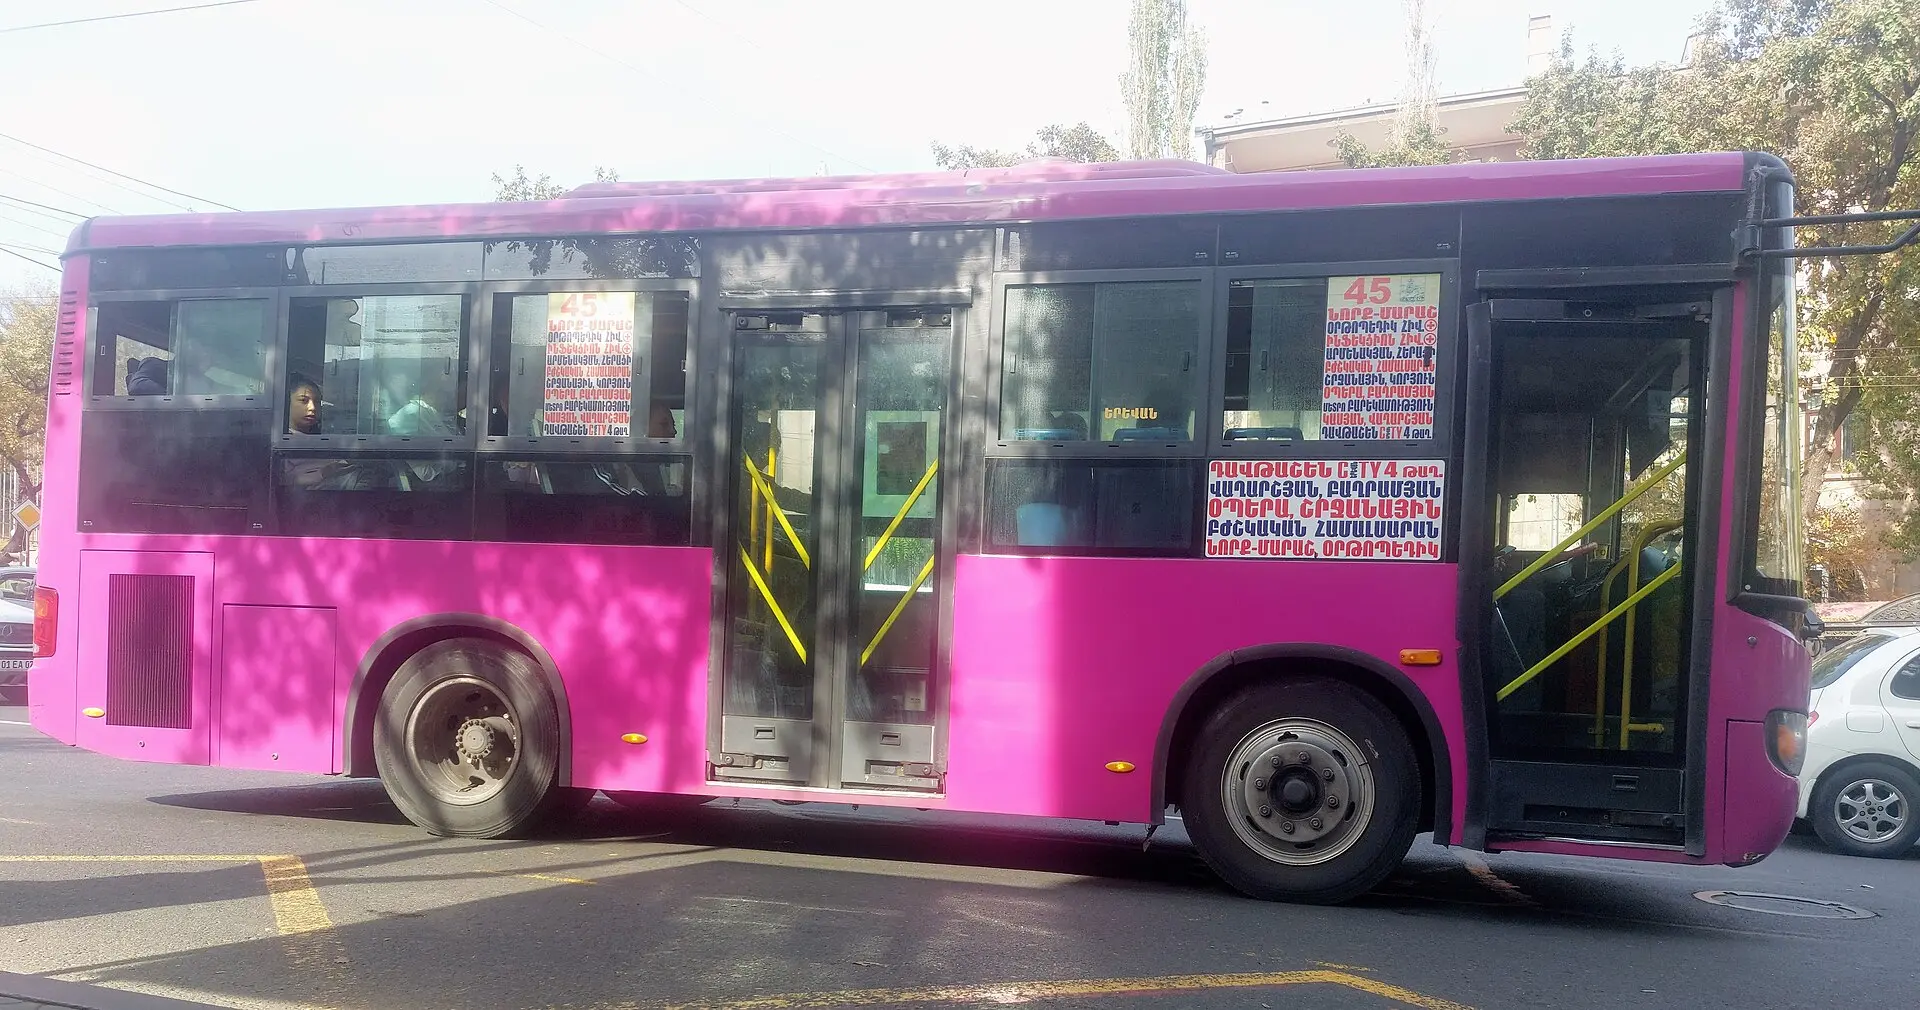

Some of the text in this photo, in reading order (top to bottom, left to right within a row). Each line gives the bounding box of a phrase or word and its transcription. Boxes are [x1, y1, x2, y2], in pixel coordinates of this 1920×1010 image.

[1343, 277, 1391, 305] 45
[561, 294, 597, 317] 45
[1327, 305, 1438, 321] ՆՈՐՔ-ՄԱՐԱՇ
[1327, 320, 1425, 334] ՕՐԹՈՊԵԴԻԿ ՀԻՎ.
[1326, 333, 1396, 347] ԻՆՖԵԿՑԻՈՆ
[1325, 346, 1436, 360] ԱՐՄԵՆԱԿՅԱՆ, ՀԵՐԱ
[1324, 360, 1373, 374] ԲԺՇԿԱԿԱՆ
[1324, 372, 1435, 386] ՇՐՋԱՆԱՅԻՆ, ԿՈՐՅՈՒՆ
[1323, 385, 1435, 400] ՕՊԵՐԱ, ԲԱՂՐԱՄՅԱՆ
[1322, 399, 1433, 412] ՄԵՏՐՈ ԲԱՐԵԿԱՄՈՒԹՅՈՒՆ
[1104, 407, 1158, 419] ԵՐԵՎԱՆ
[1322, 412, 1433, 427] ԿԱՍՅԱՆ, ՎԱՂԱՐՇՅԱՆ
[607, 424, 613, 436] 4
[1321, 426, 1378, 439] ԴԱՎԹԱՇԵՆ
[1403, 425, 1411, 439] 4
[1210, 461, 1333, 478] ԴԱՎԹԱՇԵՆ
[1383, 461, 1398, 478] 4
[1402, 465, 1443, 478] ԹԱՂ.
[1209, 480, 1441, 499] ՎԱՂԱՐՇՅԱՆ, ԲԱՂՐԱՄՅԱՆ
[1208, 498, 1441, 520] ՕՊԵՐԱ, ՇՐՋԱՆԱՅԻՆ
[1207, 519, 1439, 539] ԲԺՇԿԱԿԱՆ ՀԱՄԱԼՍԱՐԱՆ
[1206, 539, 1439, 559] ՆՈՐՔ-ՄԱՐԱՇ, ՕՐԹՈՊԵԴԻԿ
[2, 660, 11, 669] 01
[12, 660, 23, 669] EA
